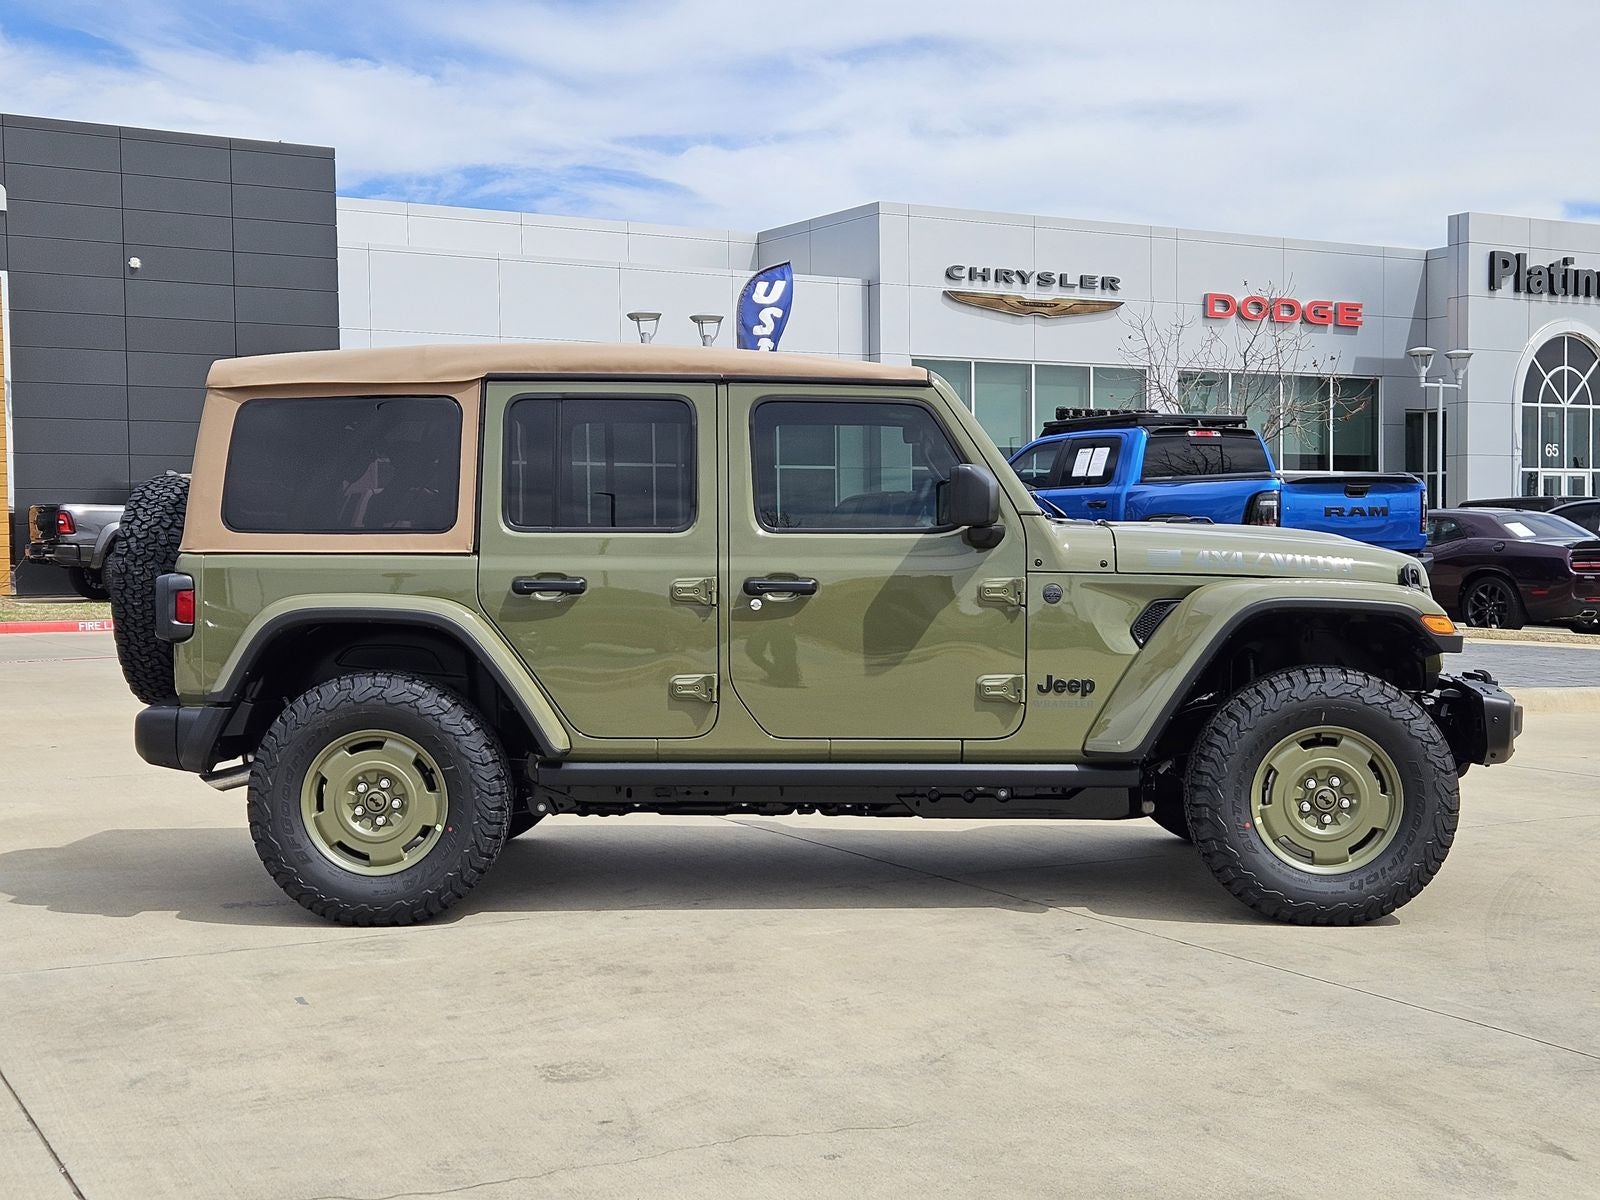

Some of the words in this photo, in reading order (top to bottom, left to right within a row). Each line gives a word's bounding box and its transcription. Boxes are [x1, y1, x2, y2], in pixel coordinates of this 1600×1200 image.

[945, 264, 1121, 291] CHRYSLER
[1488, 250, 1600, 298] Platin
[1204, 292, 1364, 327] DODGE
[1545, 443, 1559, 457] 65
[1324, 506, 1389, 517] RAM
[79, 621, 101, 631] FIRE
[1037, 674, 1096, 697] Jeep
